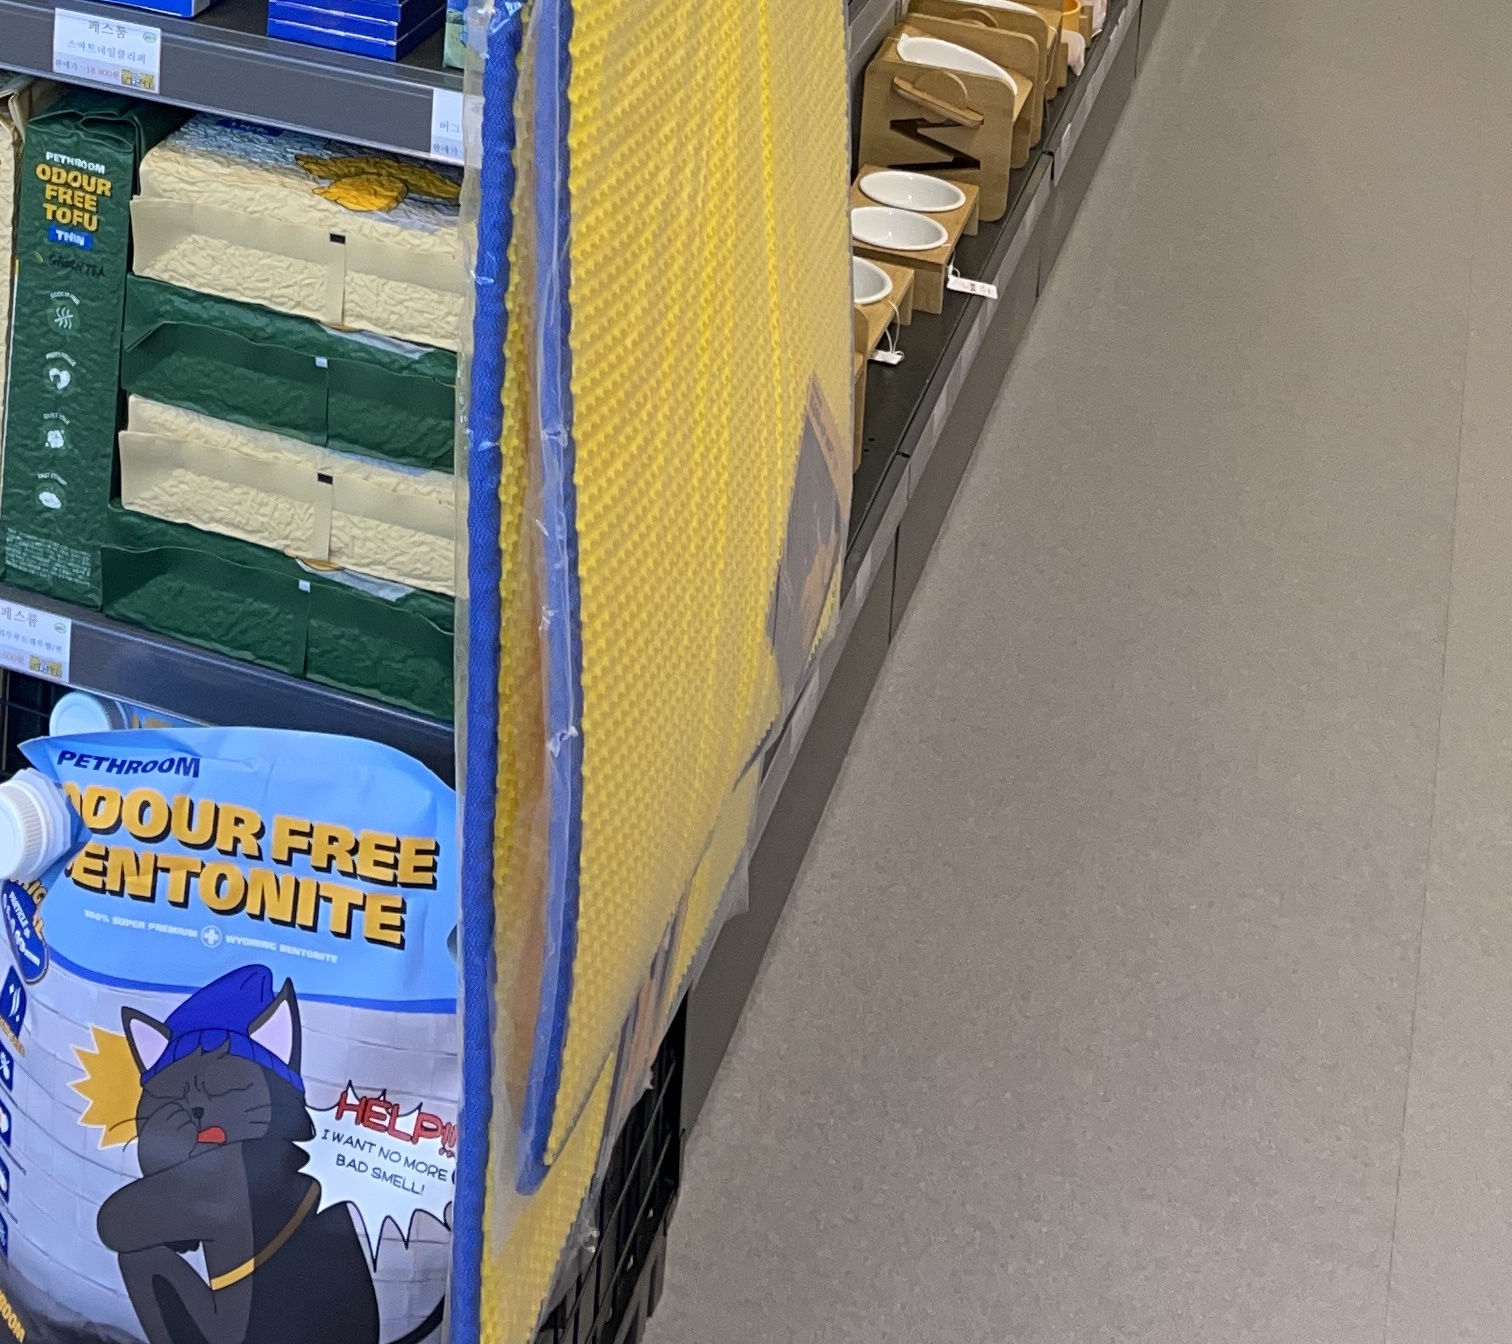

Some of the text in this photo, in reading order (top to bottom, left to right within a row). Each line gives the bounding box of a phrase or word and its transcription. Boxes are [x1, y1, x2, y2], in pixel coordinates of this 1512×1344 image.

[88, 20, 127, 39] 페스룸
[45, 151, 106, 174] PETHROOM
[36, 163, 113, 197] ODOUR
[44, 184, 99, 212] FREE
[42, 202, 99, 233] TOFU
[55, 228, 85, 248] THIN
[1, 607, 38, 628] 페스룸
[56, 749, 201, 779] PETHROOM
[272, 814, 440, 890] FREE
[66, 842, 407, 951] ENTONITE
[112, 915, 146, 931] SUPER
[322, 1129, 448, 1182] I WANT NO MORE
[336, 1154, 425, 1196] BAD SMELL!
